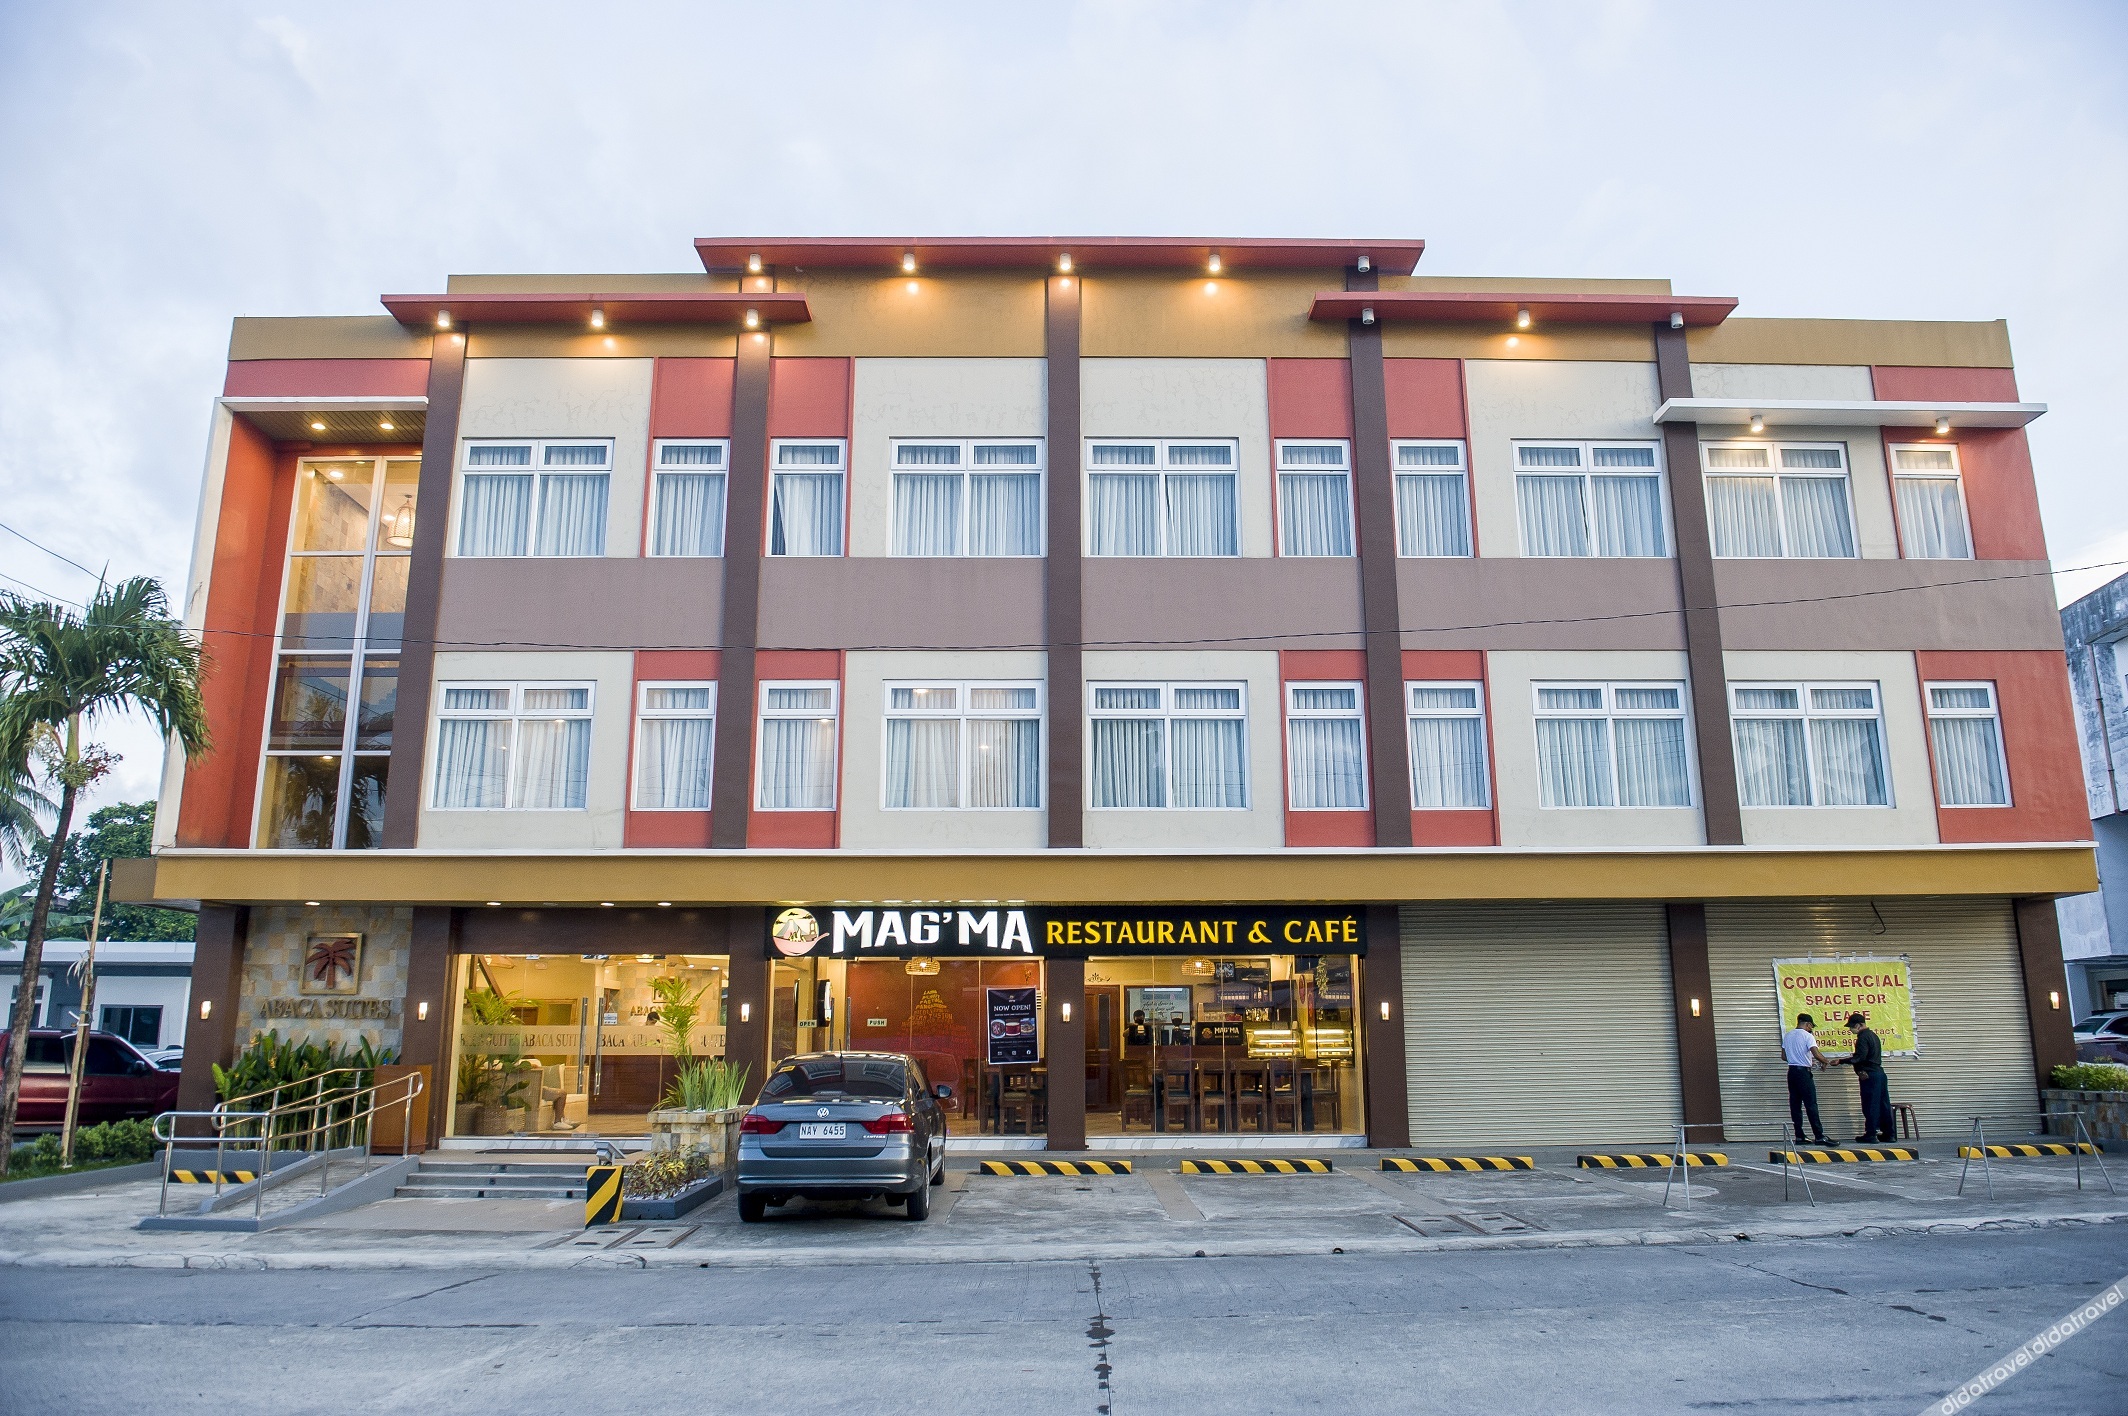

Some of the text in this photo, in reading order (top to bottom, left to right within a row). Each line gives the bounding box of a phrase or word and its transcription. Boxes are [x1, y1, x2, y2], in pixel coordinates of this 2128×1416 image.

[832, 910, 1359, 954] MAG'MA RESTAURANT & CAFÉ
[1783, 974, 1904, 989] COMMERCIAL
[1805, 994, 1886, 1006] SPACE FOR
[259, 999, 392, 1019] ABACA SUITES
[993, 1003, 1031, 1012] NOW OPEN!
[521, 1033, 554, 1047] ABACA
[801, 1125, 845, 1136] NAY 6455
